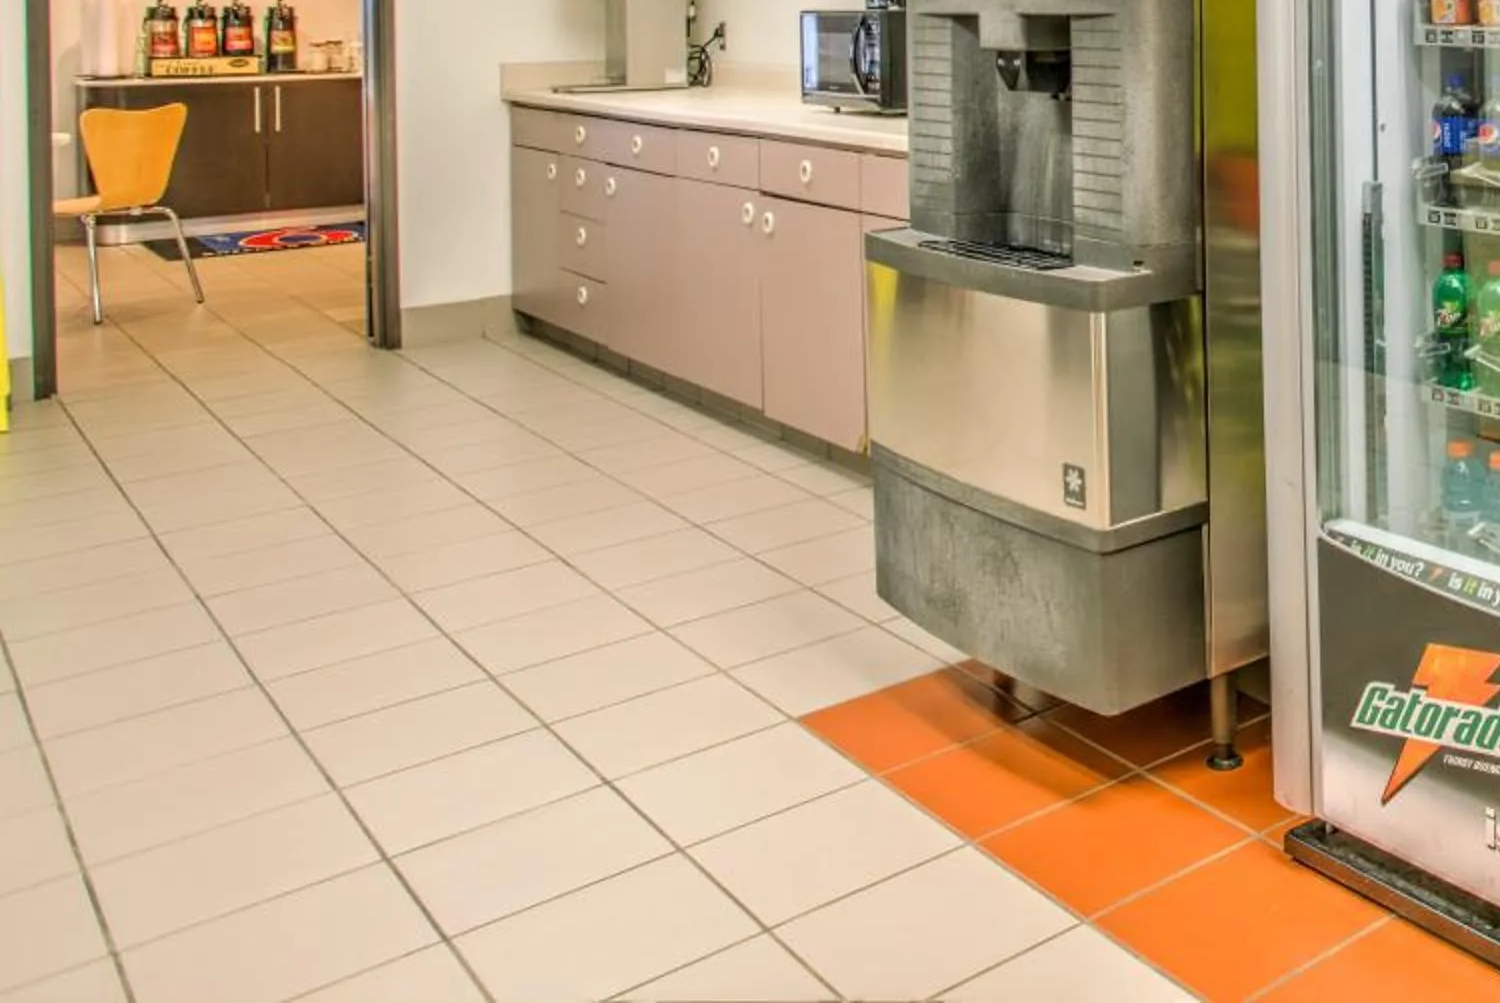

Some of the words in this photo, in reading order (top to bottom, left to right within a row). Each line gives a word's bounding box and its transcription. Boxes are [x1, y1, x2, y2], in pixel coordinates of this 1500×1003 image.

[1375, 548, 1391, 565] in
[1390, 556, 1425, 578] you?
[1448, 572, 1463, 590] is
[1463, 577, 1478, 594] it
[1477, 583, 1494, 600] in
